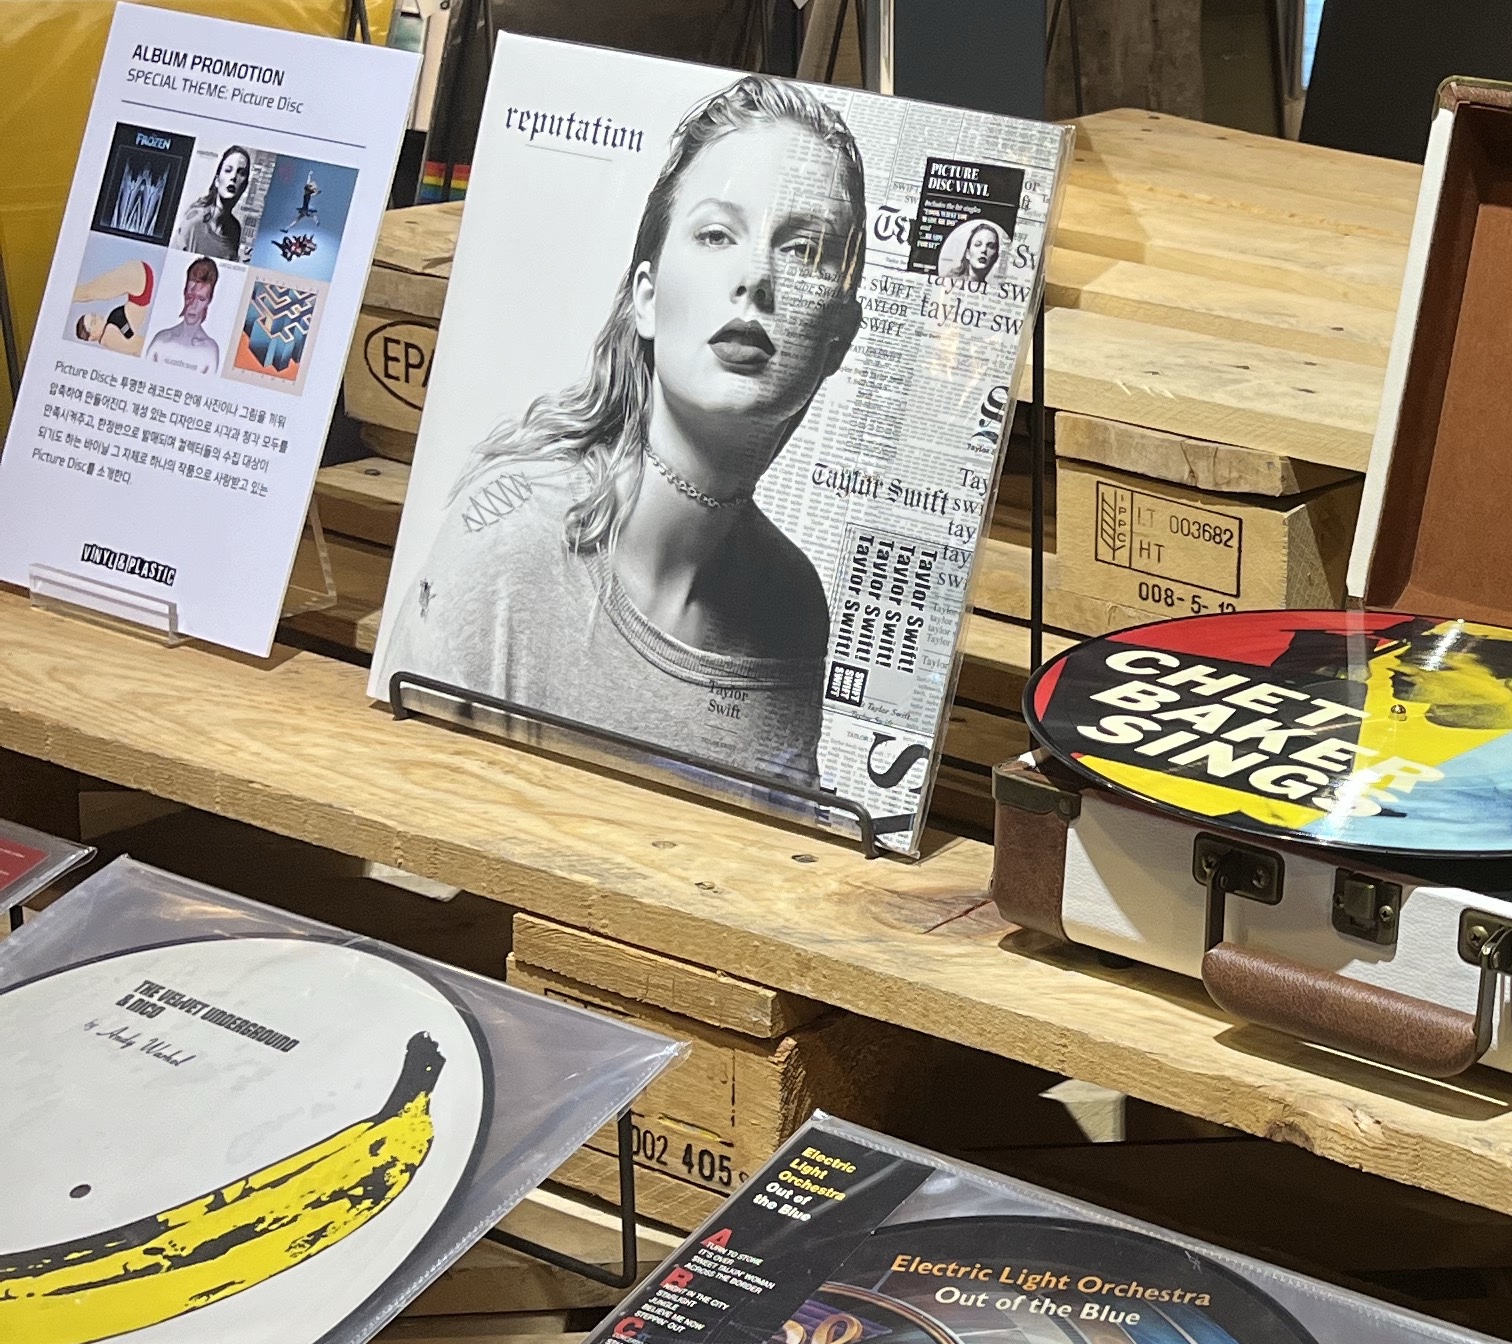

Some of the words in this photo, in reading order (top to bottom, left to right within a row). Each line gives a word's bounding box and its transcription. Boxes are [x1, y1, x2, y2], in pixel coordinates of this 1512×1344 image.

[132, 44, 187, 69] ALBUM
[190, 54, 285, 86] PROMOTION
[127, 68, 177, 90] SPECIAL
[181, 77, 228, 100] THEME:
[231, 87, 275, 109] Picture
[277, 96, 304, 114] Disc
[135, 132, 171, 150] FROZEN
[505, 107, 645, 153] reputation
[928, 178, 955, 192] DISC
[956, 181, 990, 197] VINYL
[931, 162, 980, 180] PICTURE
[920, 295, 986, 327] taylor
[150, 407, 167, 423] 있는
[32, 447, 65, 467] Picture
[811, 462, 884, 499] Taylor
[886, 478, 949, 515] Swift
[1169, 515, 1234, 549] 003682
[83, 545, 117, 569] VINYL
[117, 554, 126, 570] &
[127, 557, 176, 585] PLASTIC
[849, 536, 875, 595] Taylor
[1139, 539, 1165, 564] HT
[868, 541, 895, 601] Taylor
[889, 545, 916, 606] Taylor
[911, 551, 937, 611] Taylor
[835, 600, 860, 657] Swift!
[855, 604, 881, 662] Swift!
[875, 610, 902, 668] Swift!
[897, 616, 924, 673] Swift!
[708, 680, 749, 702] Taylor
[1106, 650, 1371, 727] CHET
[707, 701, 741, 719] Swift
[1089, 680, 1445, 794] BAKER
[1077, 714, 1382, 817] SINGS
[115, 994, 135, 1006] &
[126, 998, 166, 1019] NICO
[133, 979, 165, 998] THE
[157, 989, 211, 1016] VELVET
[200, 1006, 300, 1053] UNDERGROUND
[96, 1026, 141, 1049] Andy
[140, 1038, 197, 1067] Warhol
[682, 1143, 732, 1187] 405
[789, 1158, 829, 1180] Light
[801, 1146, 857, 1174] Electric
[766, 1182, 794, 1199] Out
[793, 1195, 813, 1206] of
[778, 1170, 846, 1201] Orchestra
[753, 1193, 778, 1210] the
[778, 1203, 812, 1222] Blue
[700, 1227, 733, 1248] A
[706, 1241, 727, 1255] TURN
[726, 1249, 739, 1258] TO
[736, 1253, 764, 1266] STONE
[684, 1262, 717, 1278] ACROSS
[715, 1272, 731, 1283] THE
[729, 1278, 763, 1295] BORDER
[890, 1254, 993, 1282] Electric
[998, 1266, 1071, 1293] Light
[1077, 1275, 1212, 1308] Orchestra
[648, 1297, 681, 1311] JUNGLE
[655, 1289, 698, 1308] STARLIGHT
[934, 1286, 989, 1308] Out
[995, 1294, 1026, 1312] of
[1029, 1297, 1072, 1319] the
[1079, 1302, 1142, 1327] Blue
